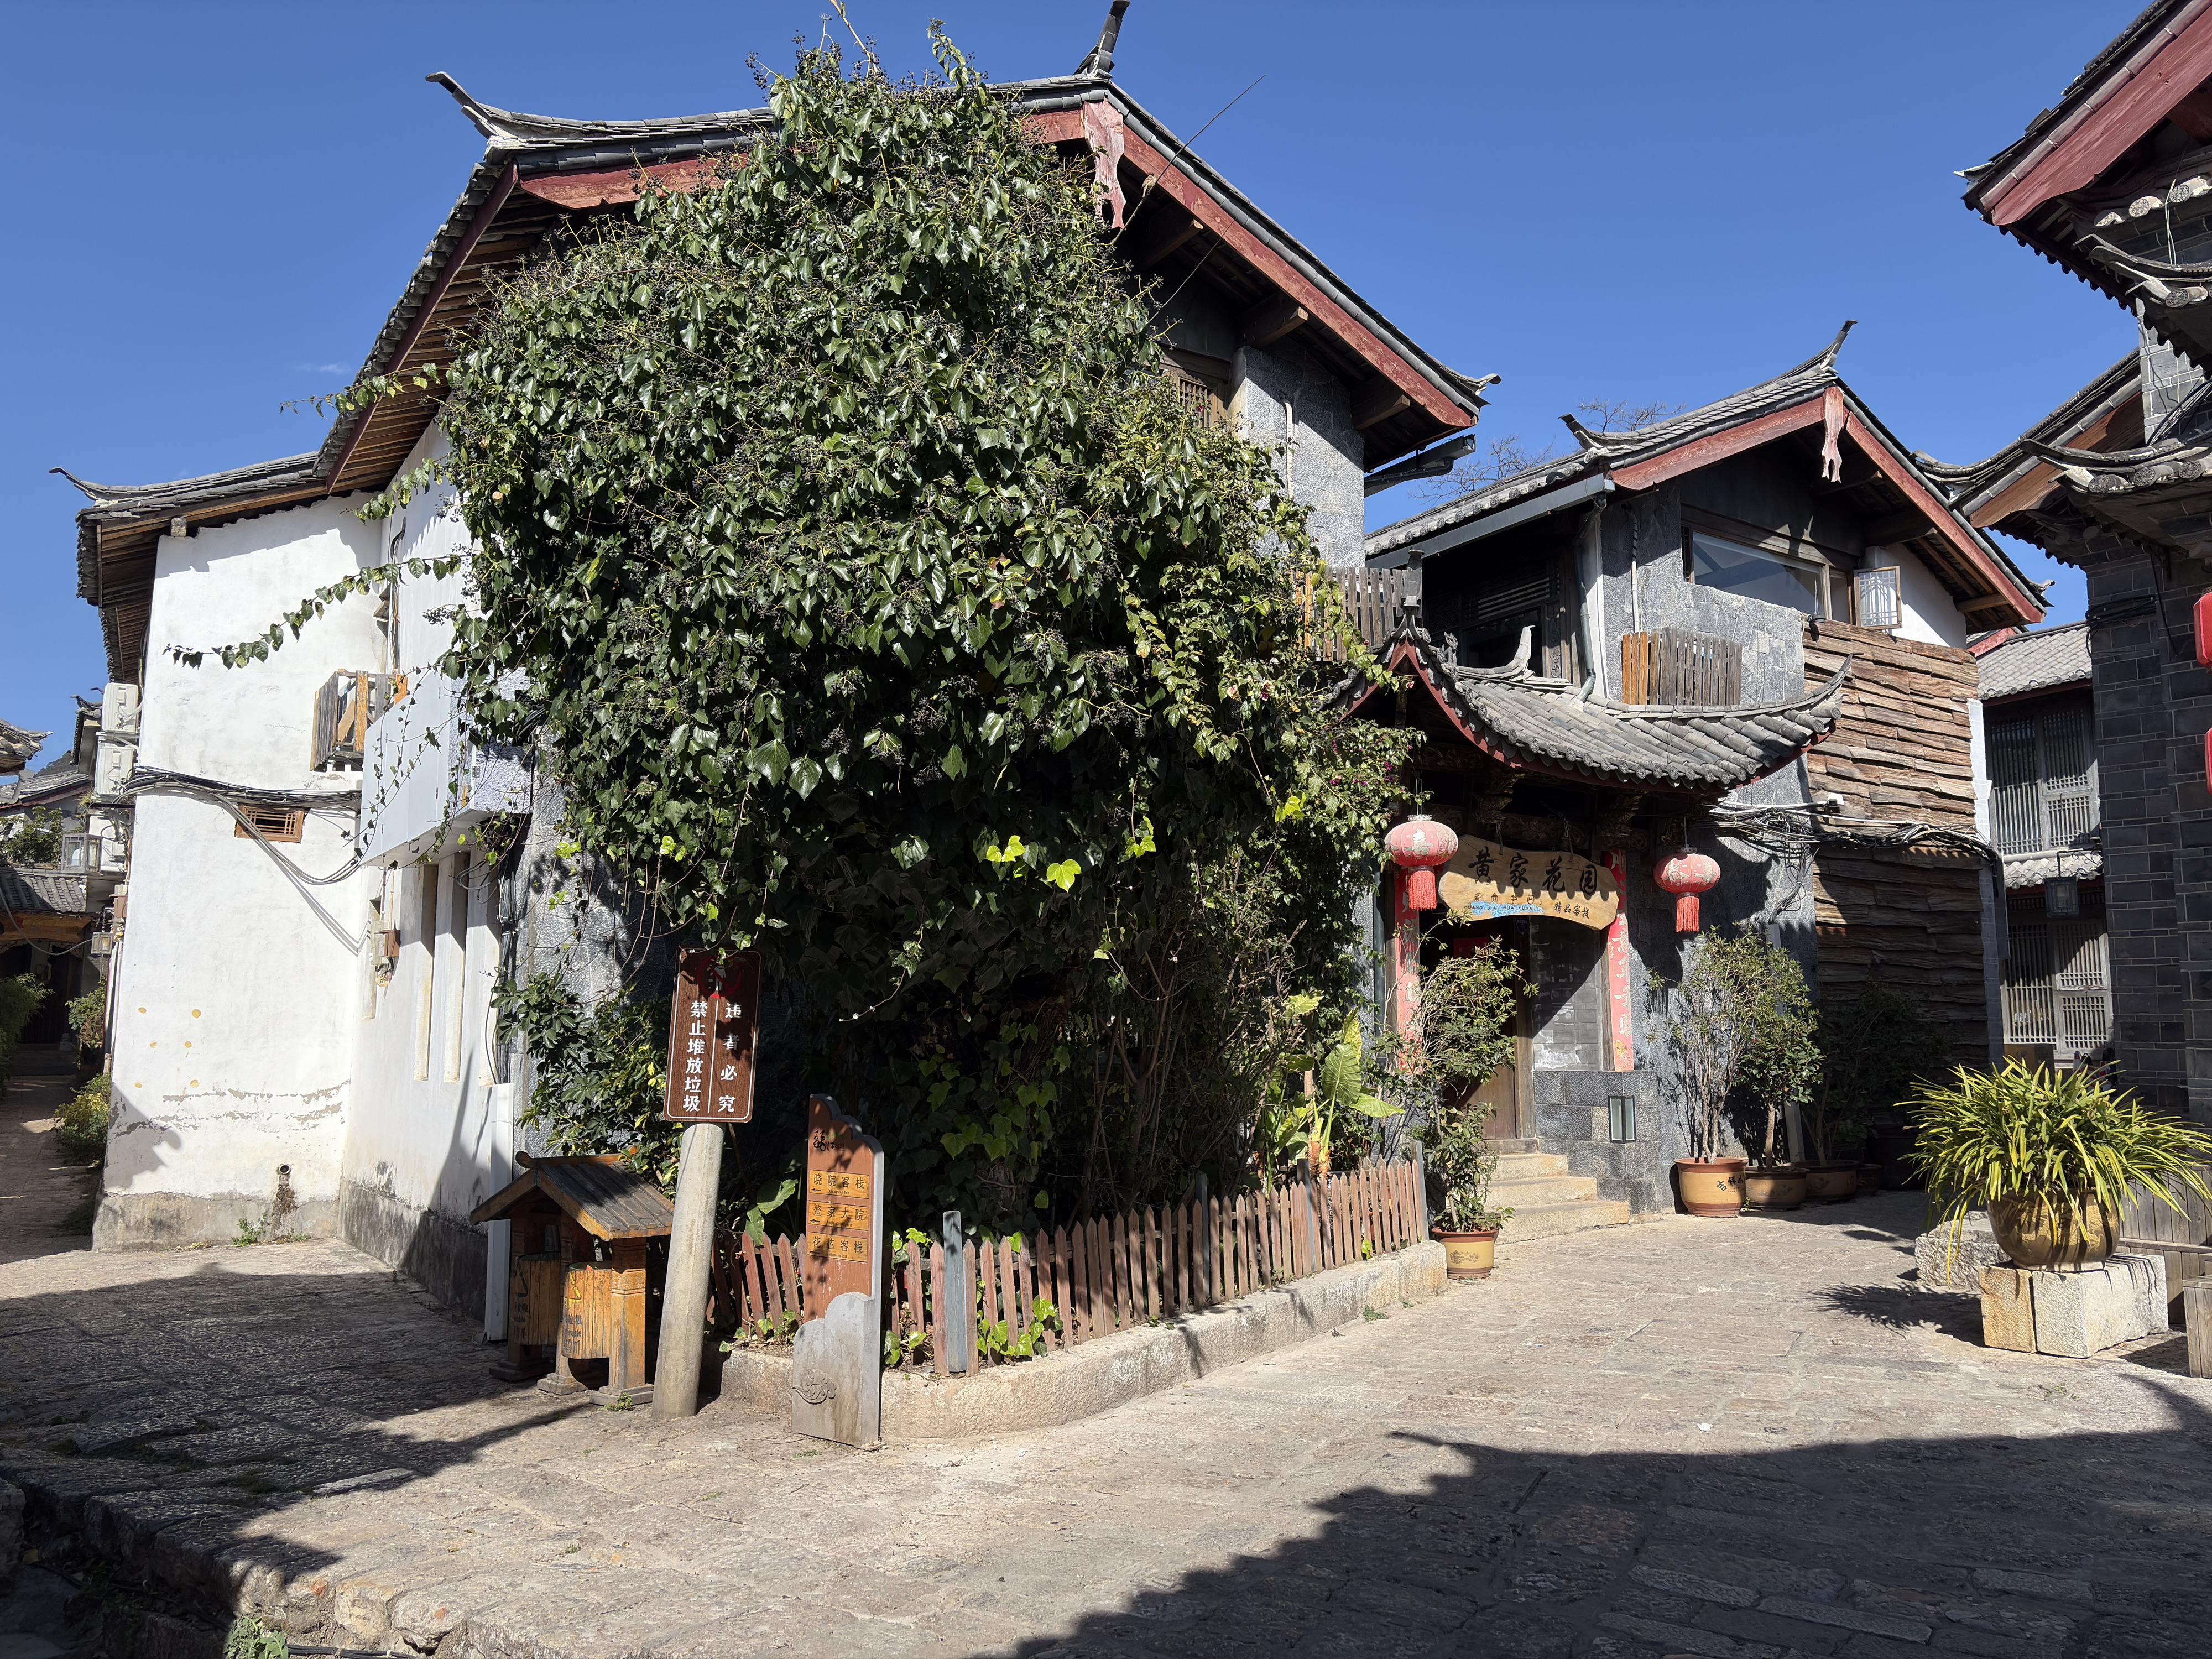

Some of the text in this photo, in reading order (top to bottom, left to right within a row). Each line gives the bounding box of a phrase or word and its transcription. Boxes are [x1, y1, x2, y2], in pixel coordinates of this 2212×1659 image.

[1554, 901, 1589, 919] 精品客栈
[682, 1000, 708, 1113] 禁止堆放垃圾
[717, 1002, 742, 1113] 违者必究
[813, 1172, 864, 1190] 晓院客栈
[812, 1235, 863, 1254] 花芯客栈
